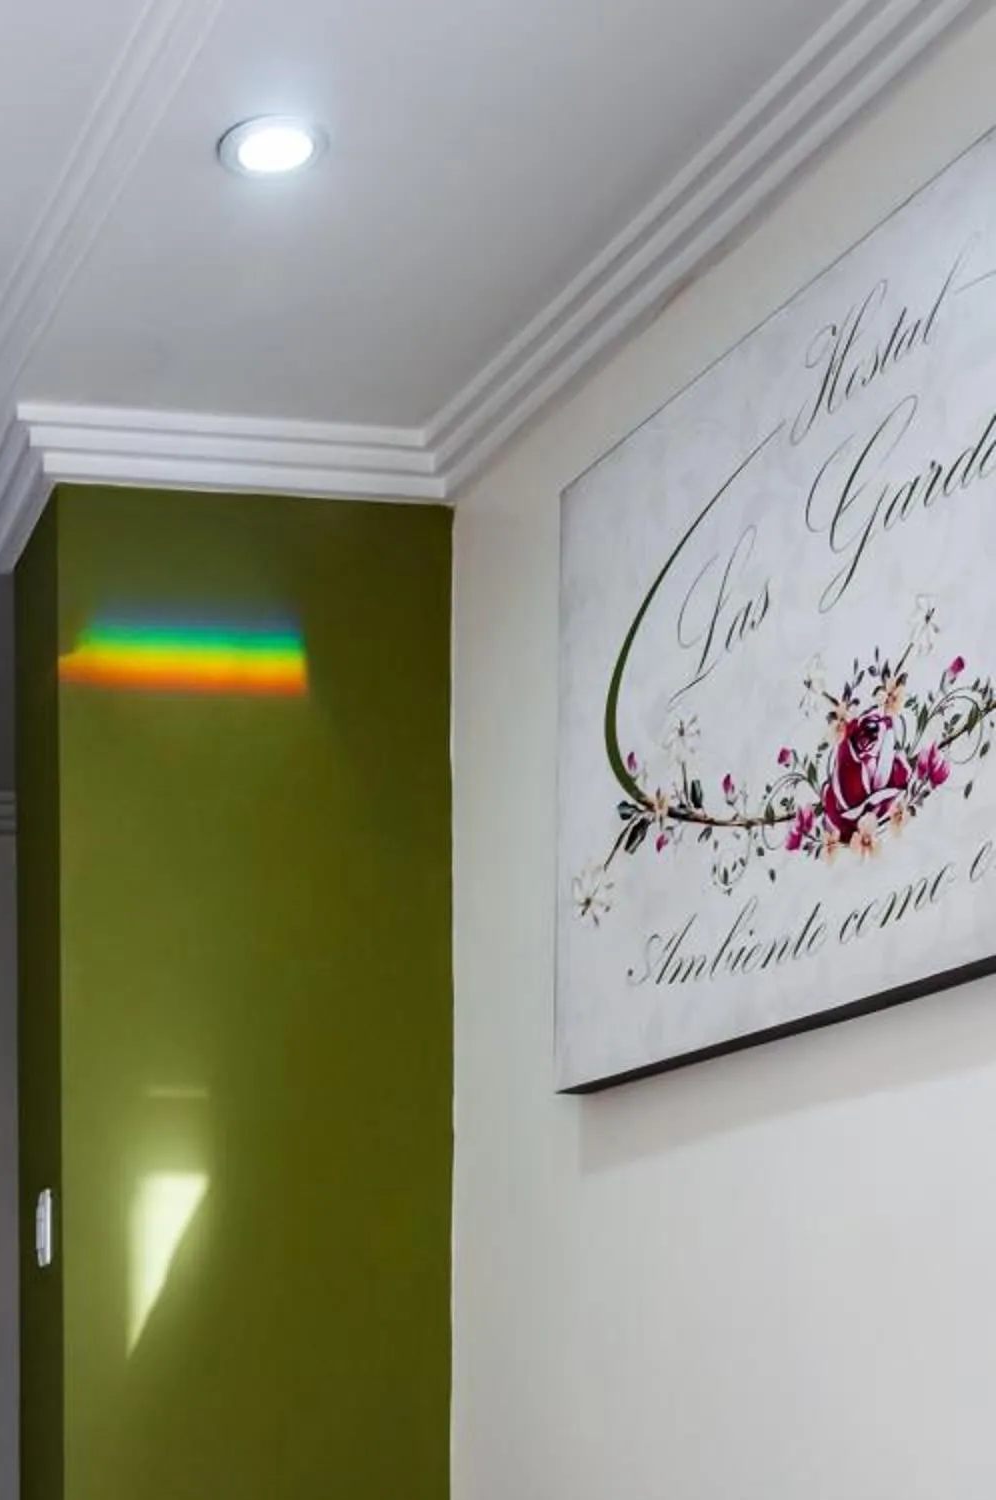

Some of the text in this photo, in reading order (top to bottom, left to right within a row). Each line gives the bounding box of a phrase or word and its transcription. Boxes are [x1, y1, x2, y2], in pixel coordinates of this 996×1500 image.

[790, 232, 978, 445] Hostal
[668, 524, 769, 712] Las
[627, 897, 830, 987] Ambiente
[839, 862, 957, 944] como
